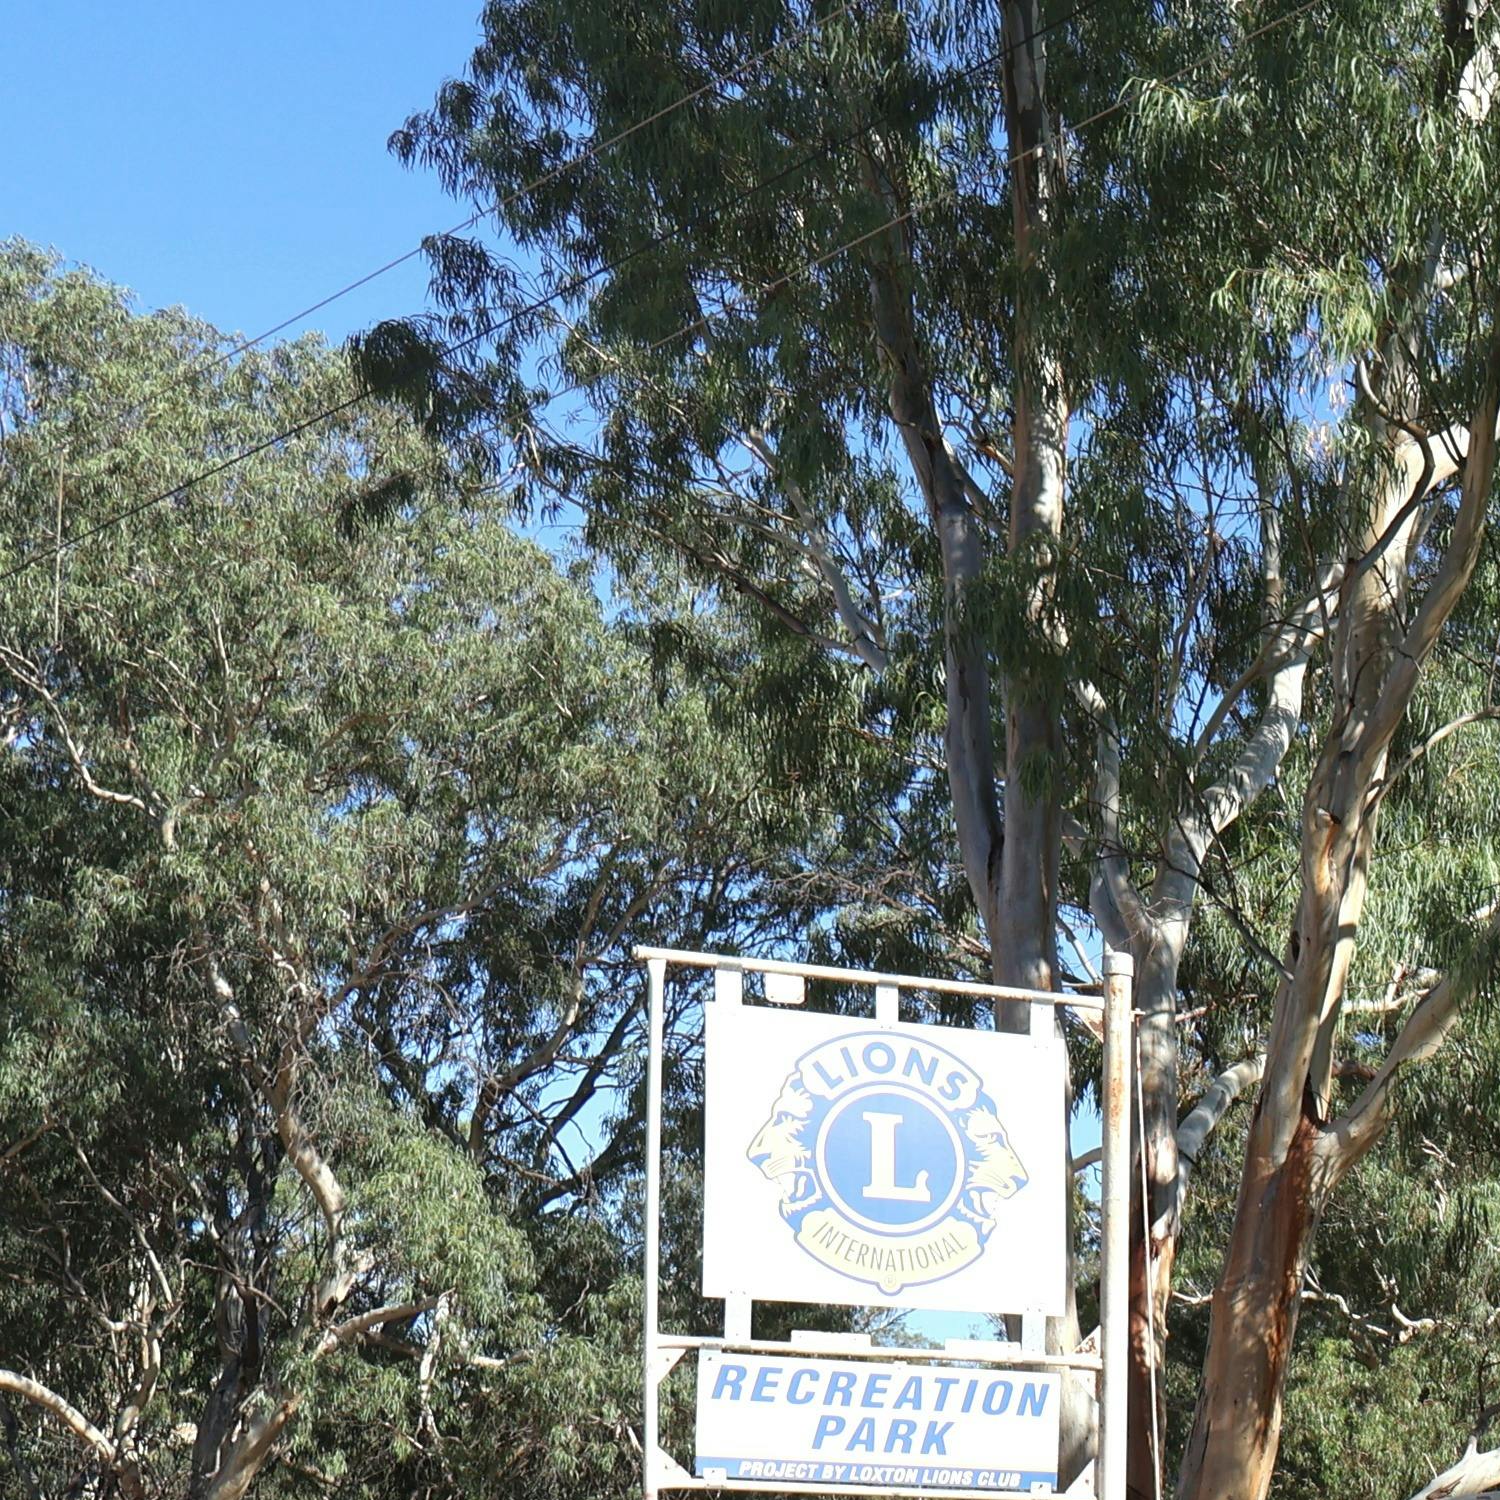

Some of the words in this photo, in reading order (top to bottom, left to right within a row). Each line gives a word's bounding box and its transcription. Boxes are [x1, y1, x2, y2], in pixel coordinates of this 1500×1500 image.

[812, 1041, 969, 1101] LIONS
[862, 1112, 931, 1202] L
[811, 1221, 968, 1272] INTERNATIONAL
[711, 1363, 1050, 1417] RECREATION
[811, 1414, 955, 1456] PARK
[738, 1460, 819, 1480] PROJECT
[822, 1464, 848, 1480] BY
[850, 1466, 918, 1484] LOXTON
[922, 1469, 973, 1486] LIONS
[977, 1471, 1022, 1488] CLUB
